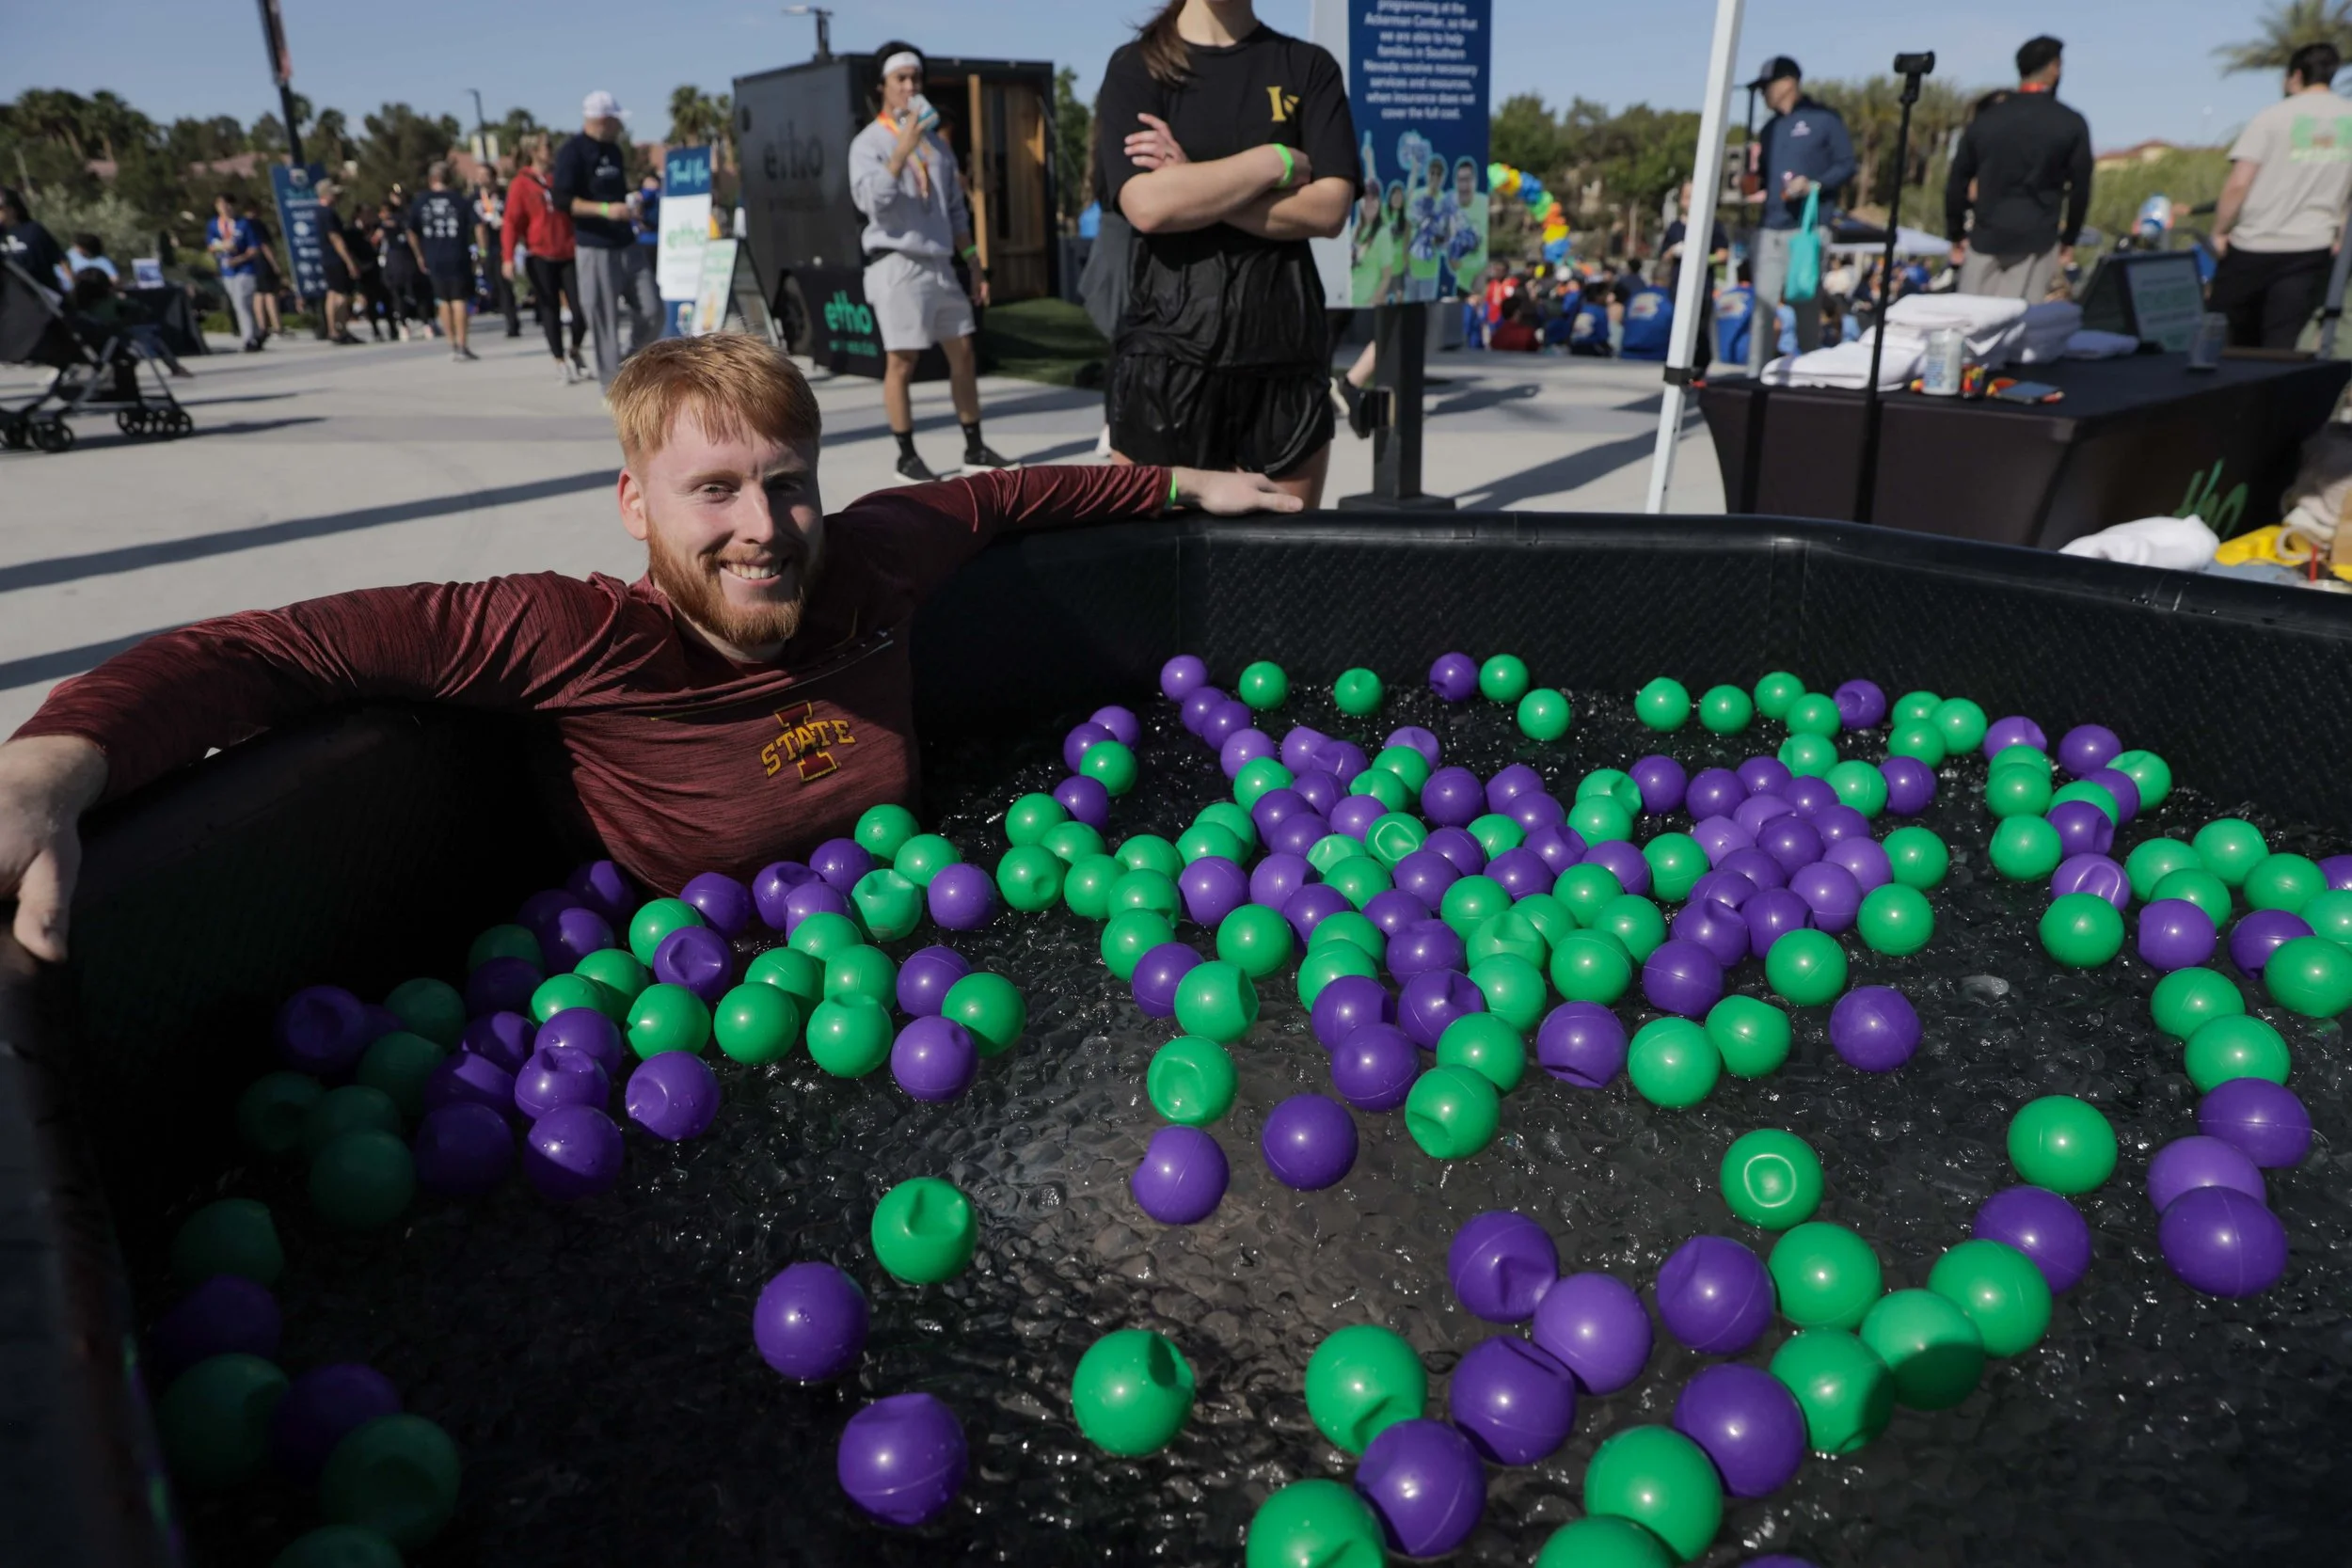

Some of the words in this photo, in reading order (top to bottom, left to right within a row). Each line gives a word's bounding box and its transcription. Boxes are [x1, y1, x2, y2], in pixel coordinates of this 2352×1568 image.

[1379, 32, 1394, 41] we
[824, 290, 873, 335] etho
[761, 720, 855, 777] STATE
